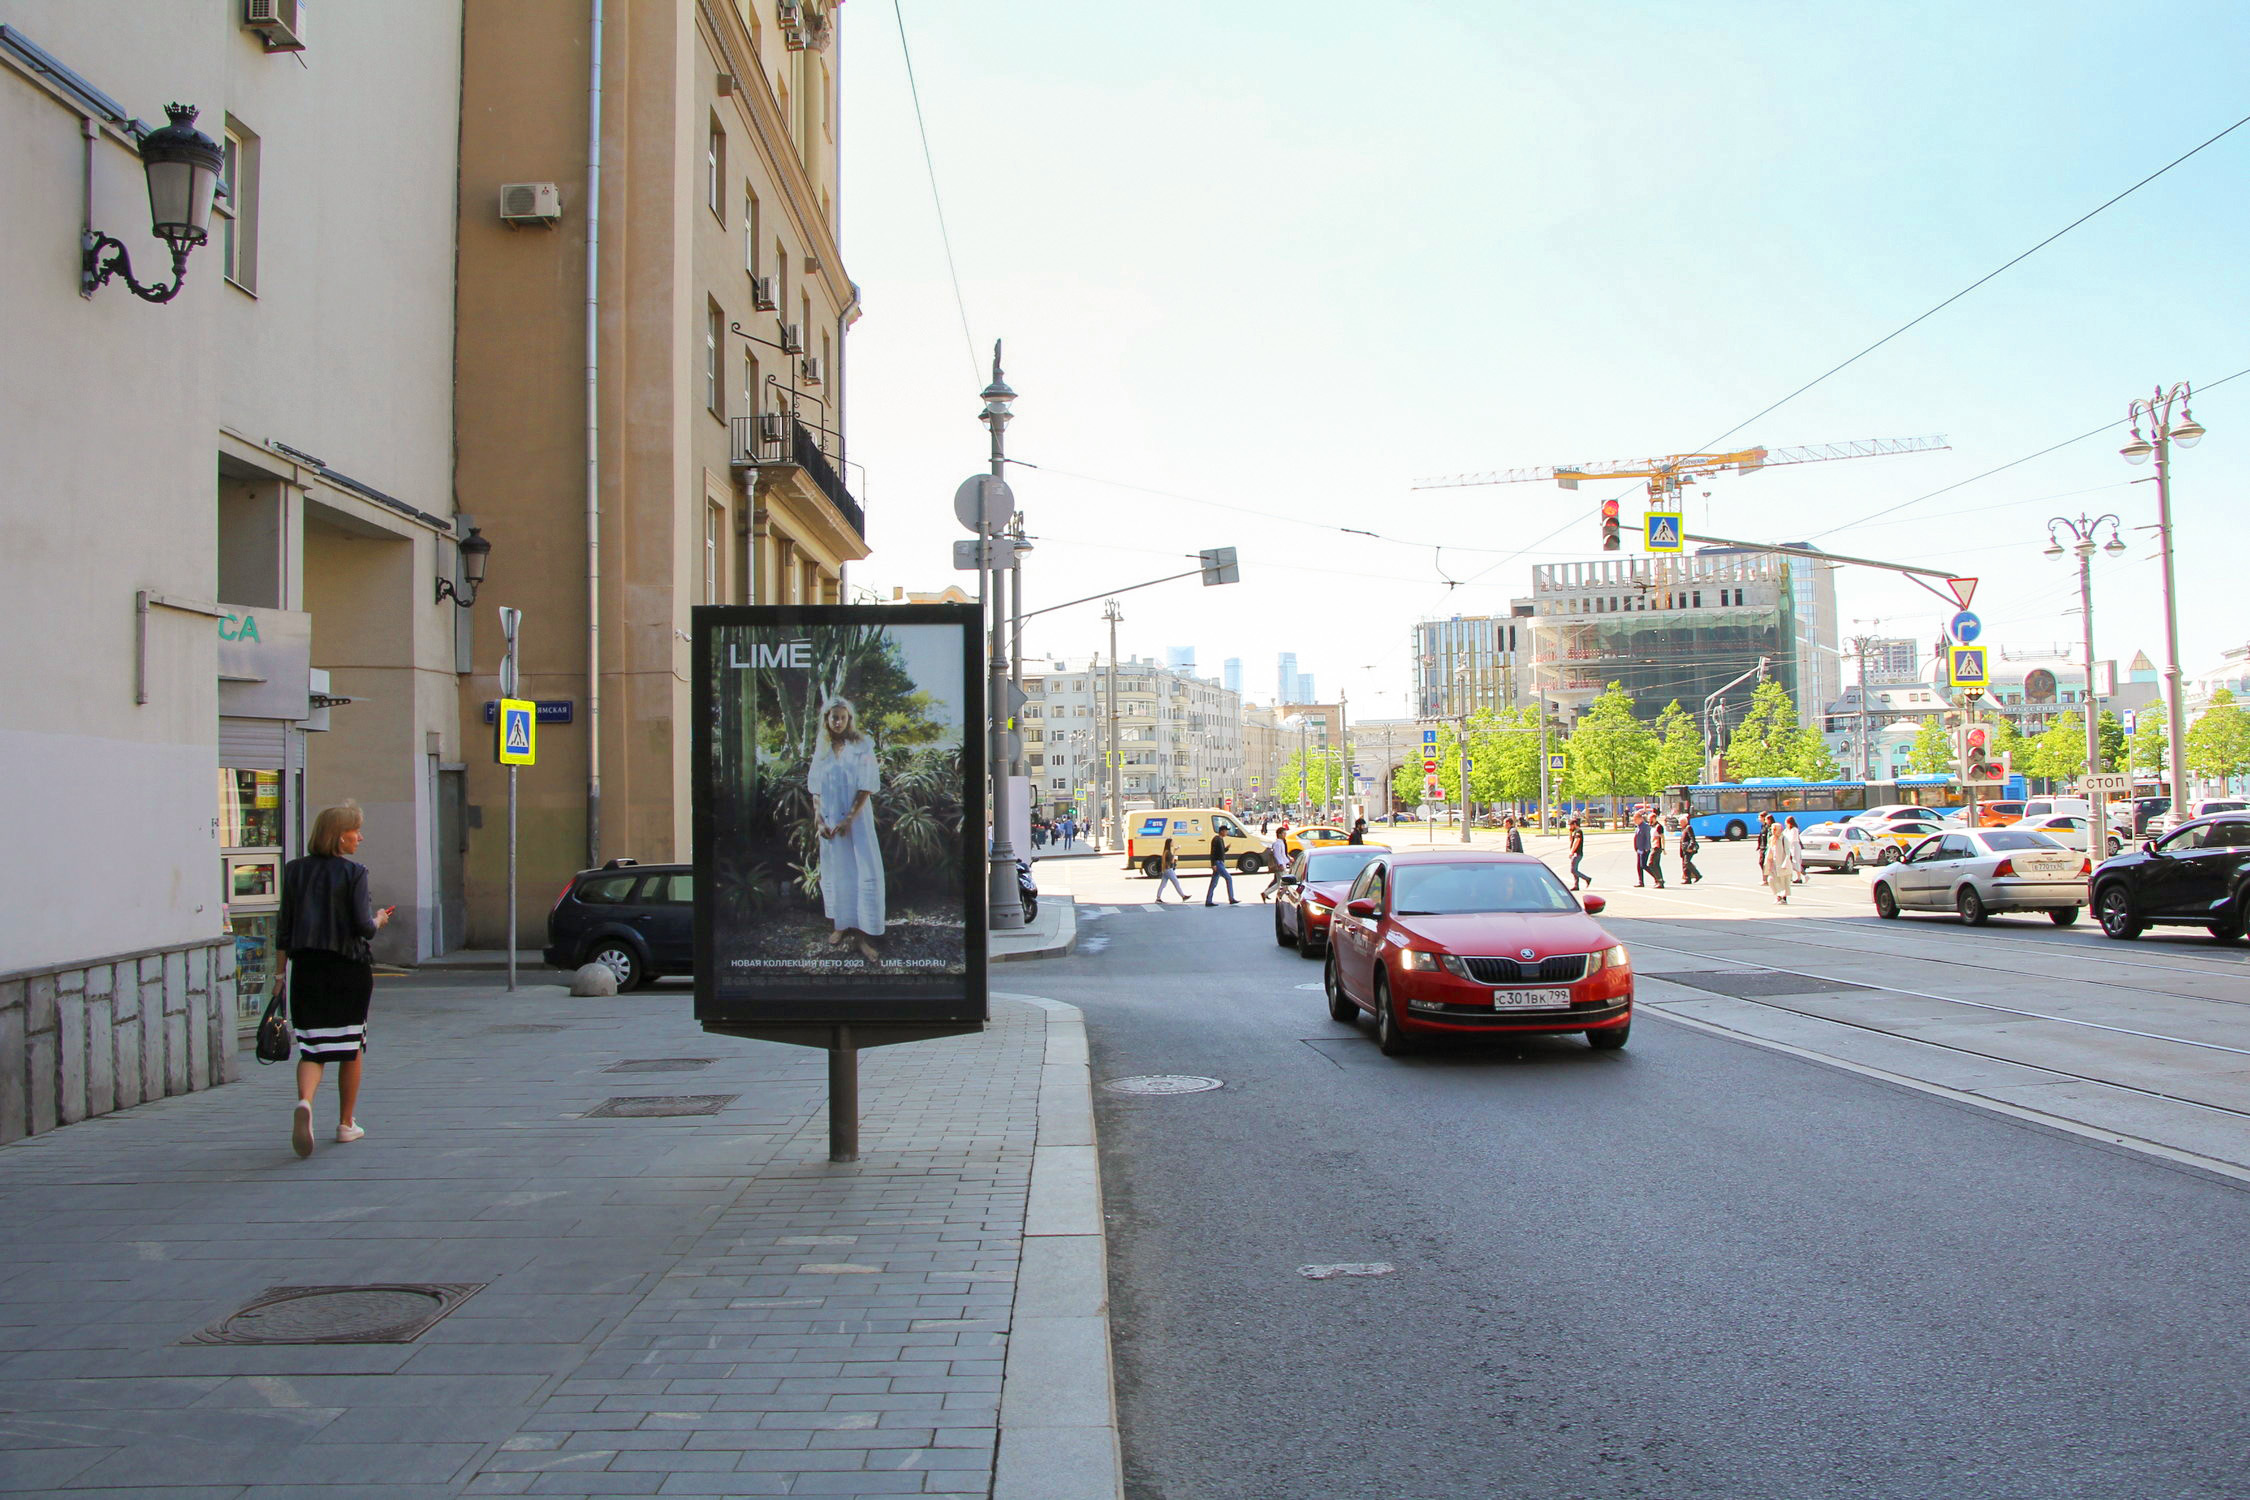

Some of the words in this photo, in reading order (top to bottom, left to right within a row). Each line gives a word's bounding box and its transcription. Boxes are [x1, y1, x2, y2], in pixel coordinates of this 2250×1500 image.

[2086, 777, 2125, 789] СТОП
[731, 959, 761, 967] НОВАЯ
[763, 959, 817, 968] КОЛЛЕКЦИЯ
[819, 959, 843, 967] ЛЕТО
[844, 959, 864, 967] 2023
[880, 959, 946, 967] LIME-SHOP.RU
